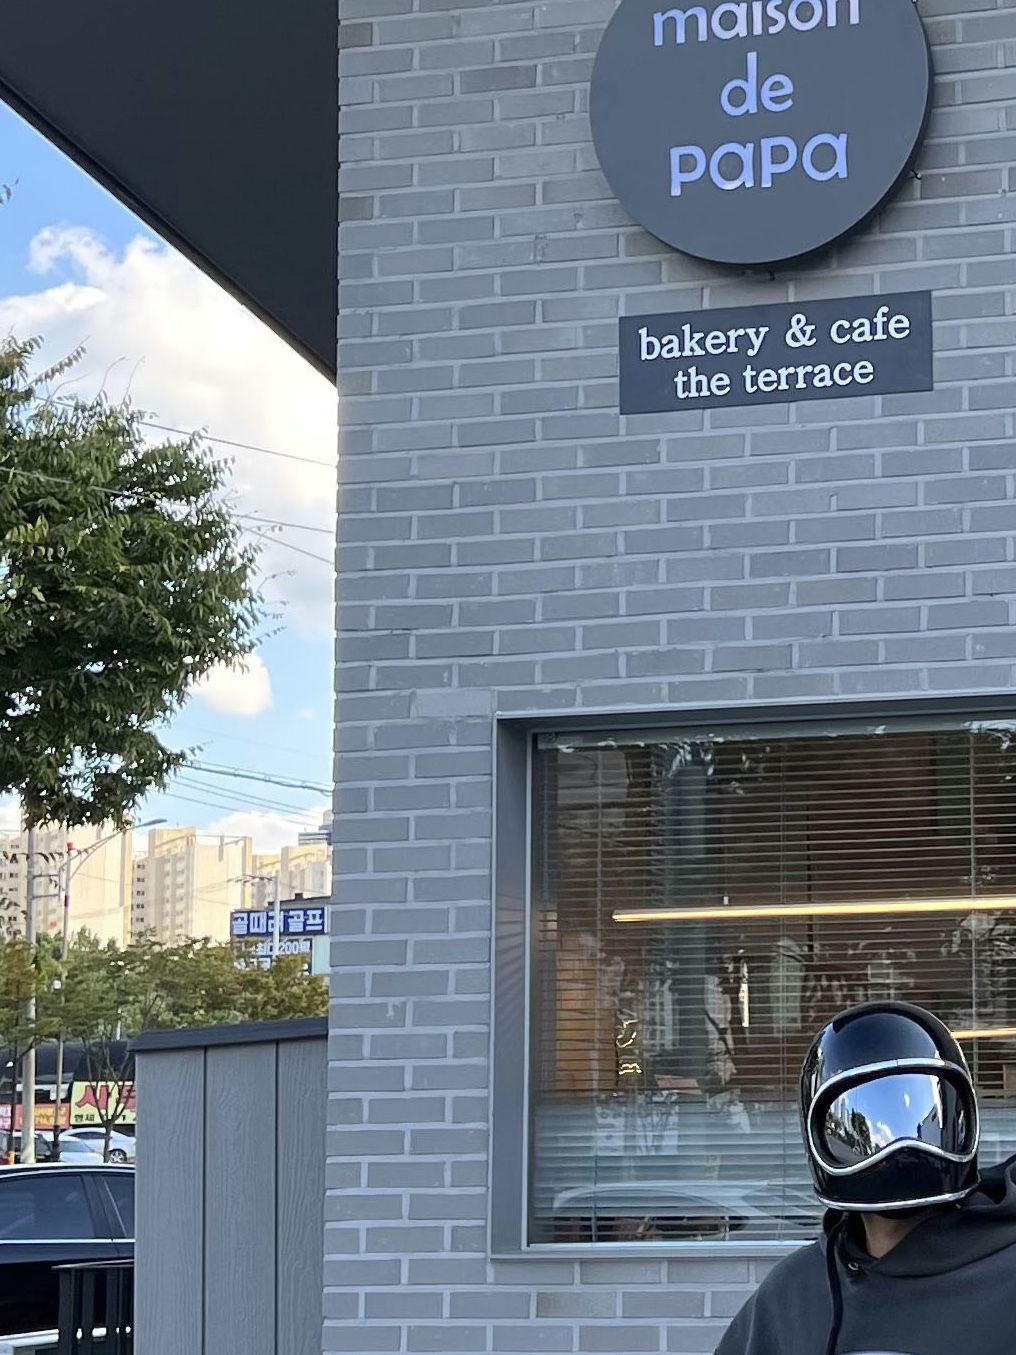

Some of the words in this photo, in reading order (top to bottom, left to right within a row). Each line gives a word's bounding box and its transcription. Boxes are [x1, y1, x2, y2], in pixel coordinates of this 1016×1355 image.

[653, 0, 860, 46] maison
[720, 51, 795, 117] de
[669, 132, 849, 197] papa
[638, 323, 769, 361] bakery
[785, 312, 817, 348] &
[830, 306, 911, 344] cafe
[674, 367, 731, 400] the
[743, 359, 875, 395] terrace
